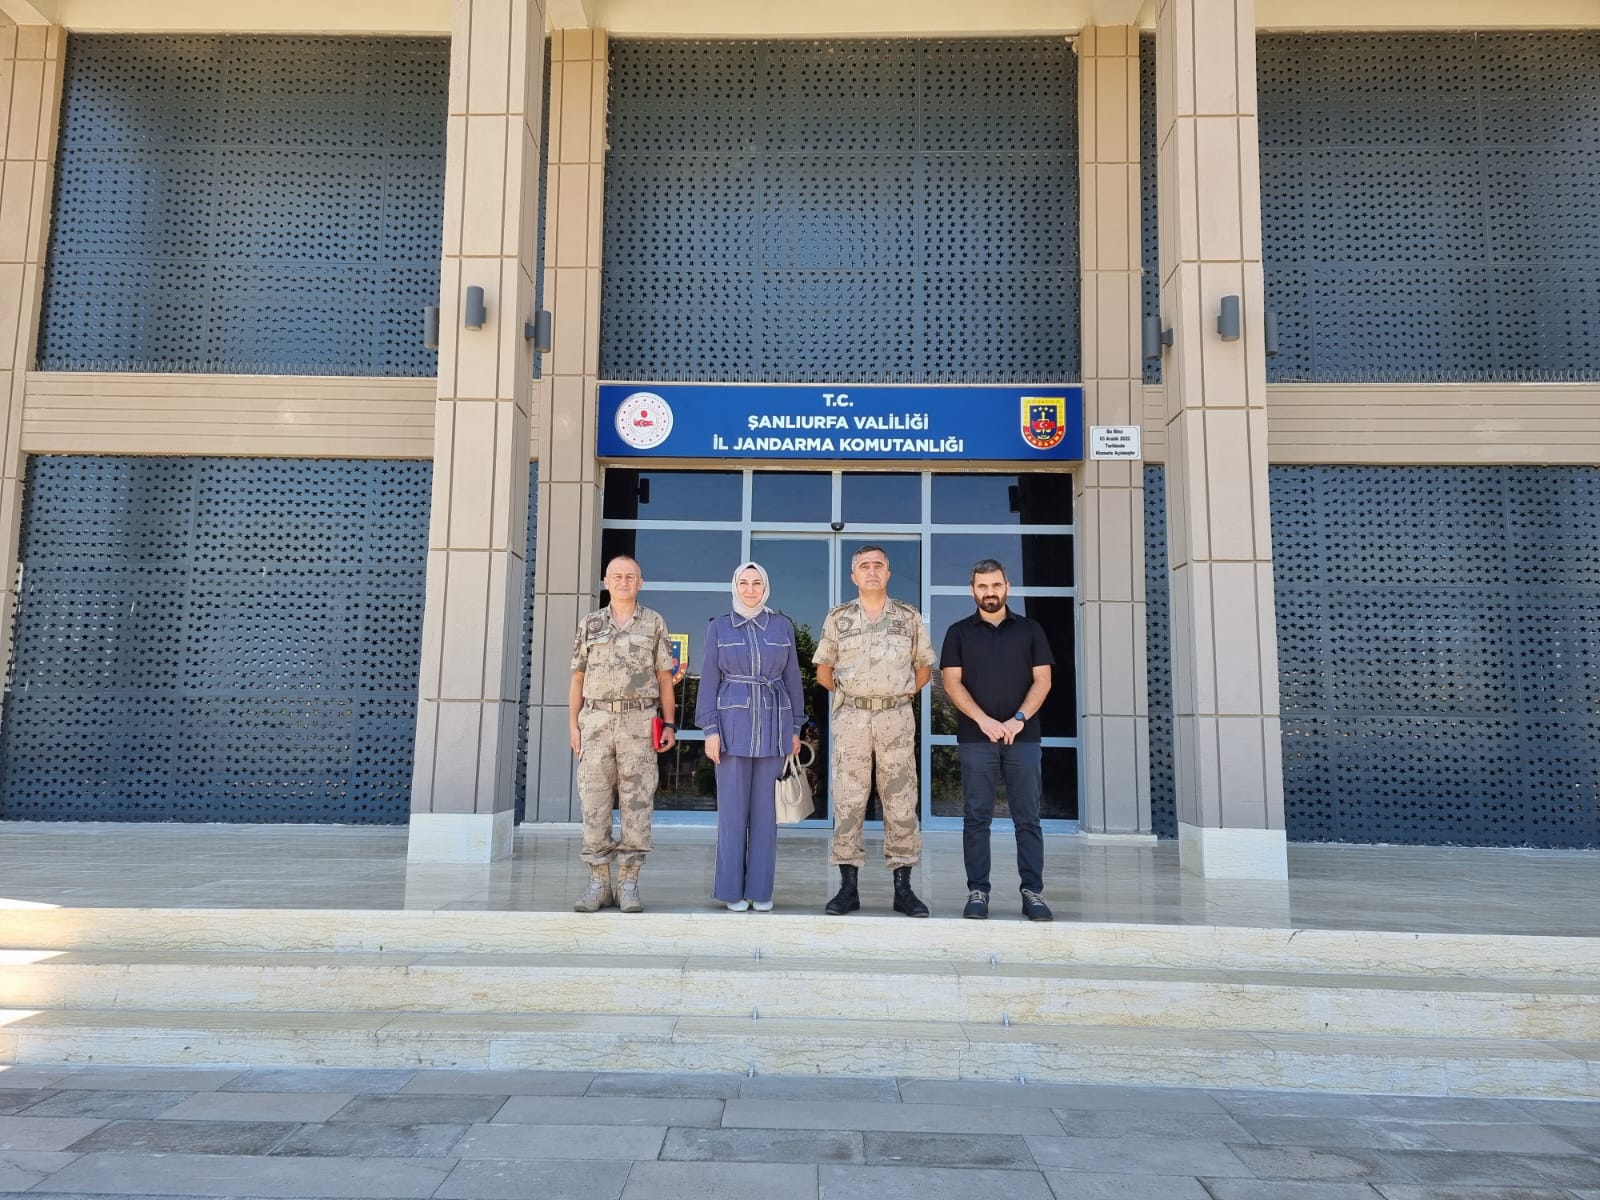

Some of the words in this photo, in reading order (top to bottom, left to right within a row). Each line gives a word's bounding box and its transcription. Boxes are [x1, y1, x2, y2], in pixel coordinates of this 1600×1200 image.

[822, 393, 854, 408] T.C.
[747, 414, 849, 431] ŞANLIURFA
[854, 413, 929, 430] VALİLİĞİ
[713, 434, 728, 450] İL
[733, 437, 834, 452] JANDARMA
[839, 436, 964, 453] KOMUTANLIĞI
